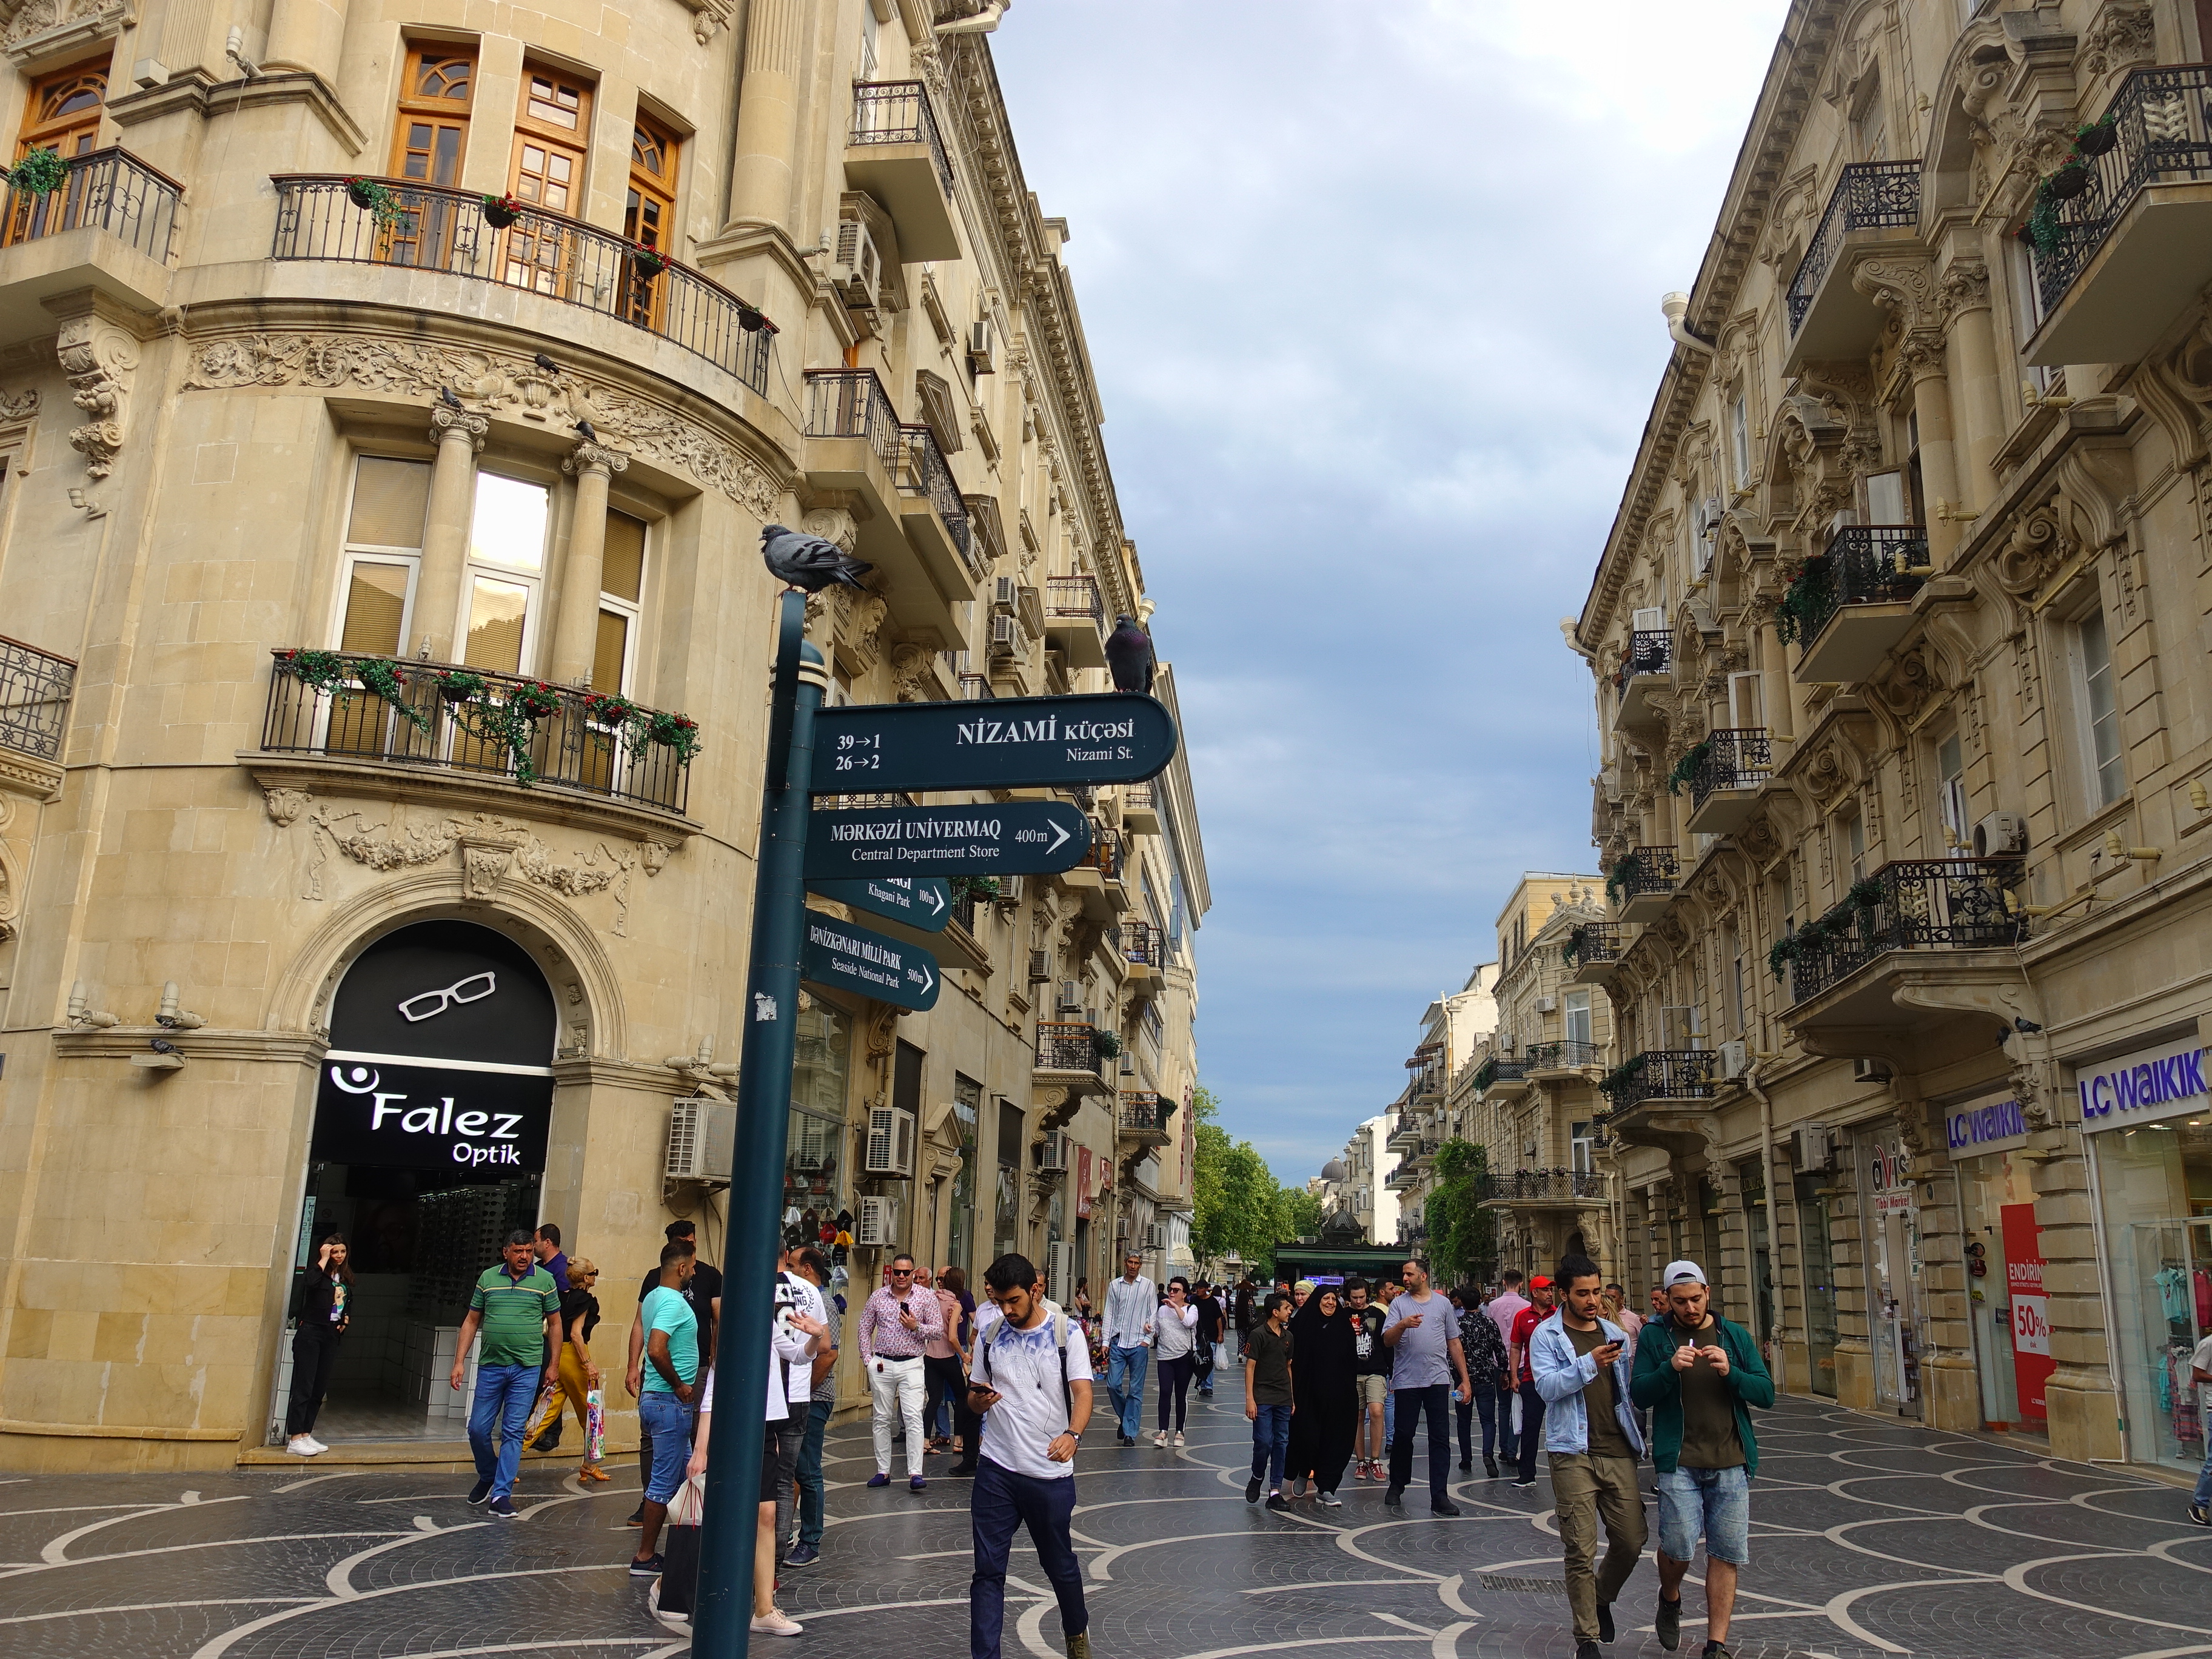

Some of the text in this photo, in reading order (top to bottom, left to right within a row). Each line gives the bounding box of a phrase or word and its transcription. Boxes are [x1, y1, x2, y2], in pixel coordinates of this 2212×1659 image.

[837, 734, 880, 750] 39 1
[956, 714, 1134, 745] NİZAMİ KÜÇƏSİ
[836, 754, 880, 770] 26 2
[1066, 746, 1134, 762] Nizami St.
[830, 817, 1001, 841] MƏRKƏZİ UNİVERMAQ
[1014, 830, 1048, 843] 400m
[852, 845, 1000, 862] Central Department Store
[868, 883, 911, 908] Khagani Park
[919, 889, 935, 905] 100m
[810, 925, 902, 970] DƏNİZKƏNARI MİLLİ PARK
[831, 957, 899, 988] Seaside National Park
[907, 968, 923, 984] 500m
[2080, 1075, 2111, 1119] LC
[371, 1092, 524, 1139] Falez
[1946, 1113, 1967, 1148] LC
[452, 1142, 521, 1167] Optik
[1871, 1141, 1909, 1193] avis
[1889, 1194, 1909, 1208] Market
[2017, 1305, 2046, 1338] 50%
